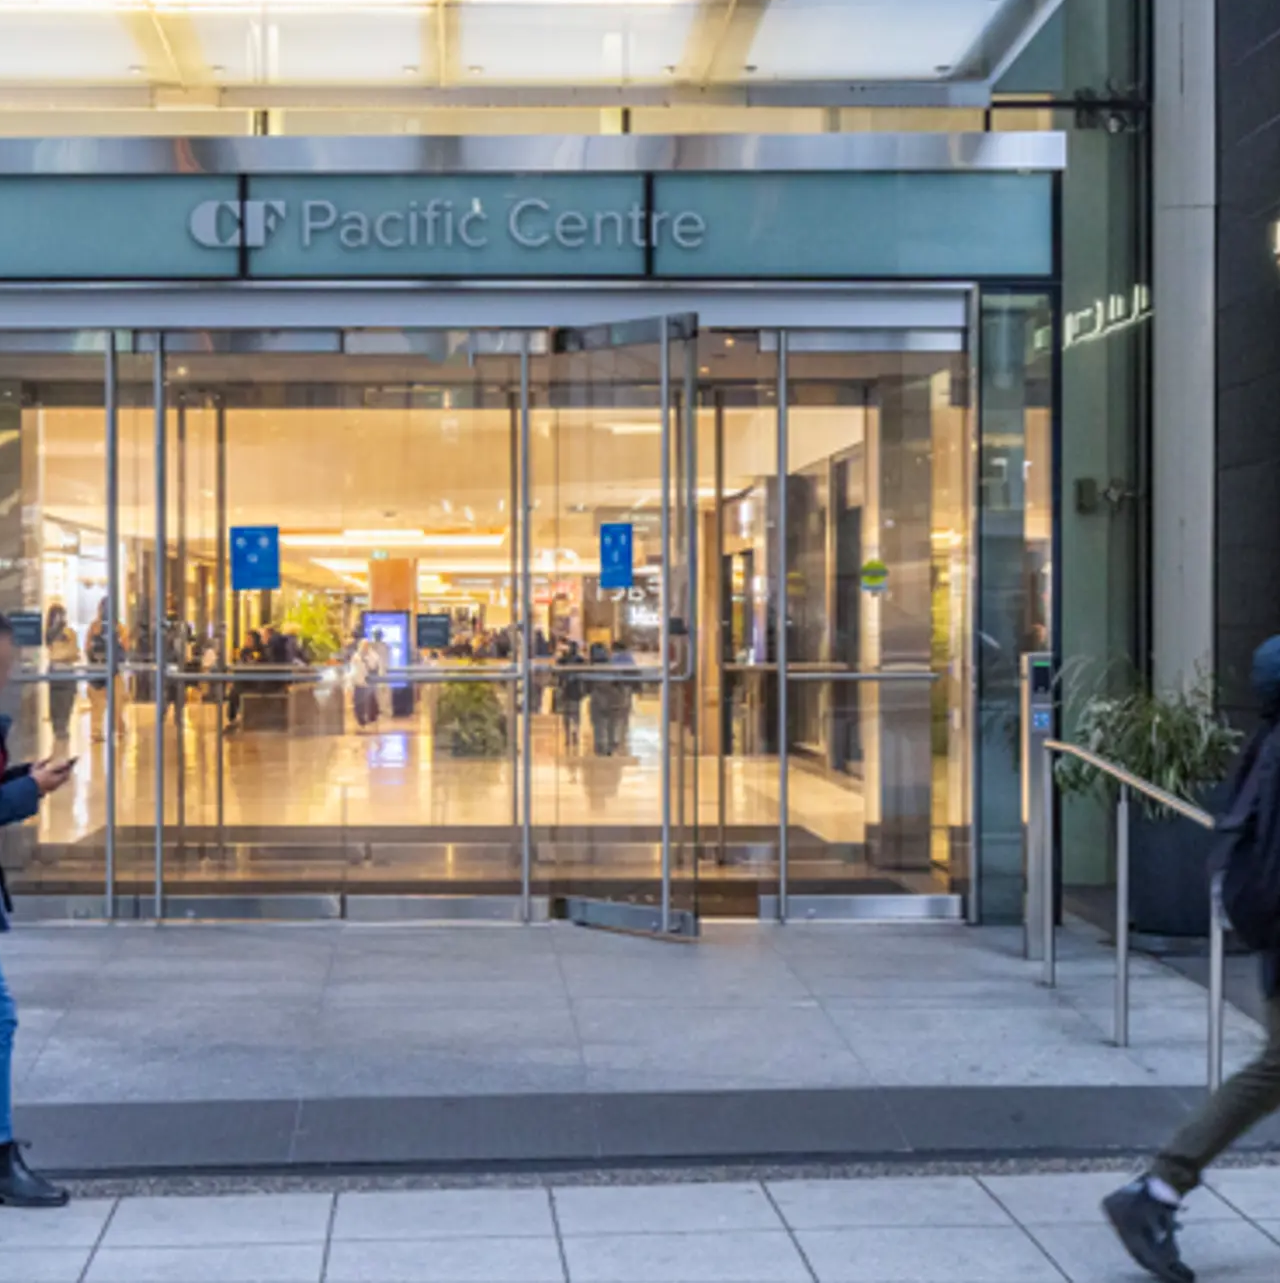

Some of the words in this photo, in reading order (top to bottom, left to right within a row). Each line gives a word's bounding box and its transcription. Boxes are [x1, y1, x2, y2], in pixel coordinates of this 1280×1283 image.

[189, 200, 286, 248] CF
[301, 196, 488, 249] Pacific
[509, 196, 706, 250] Centre
